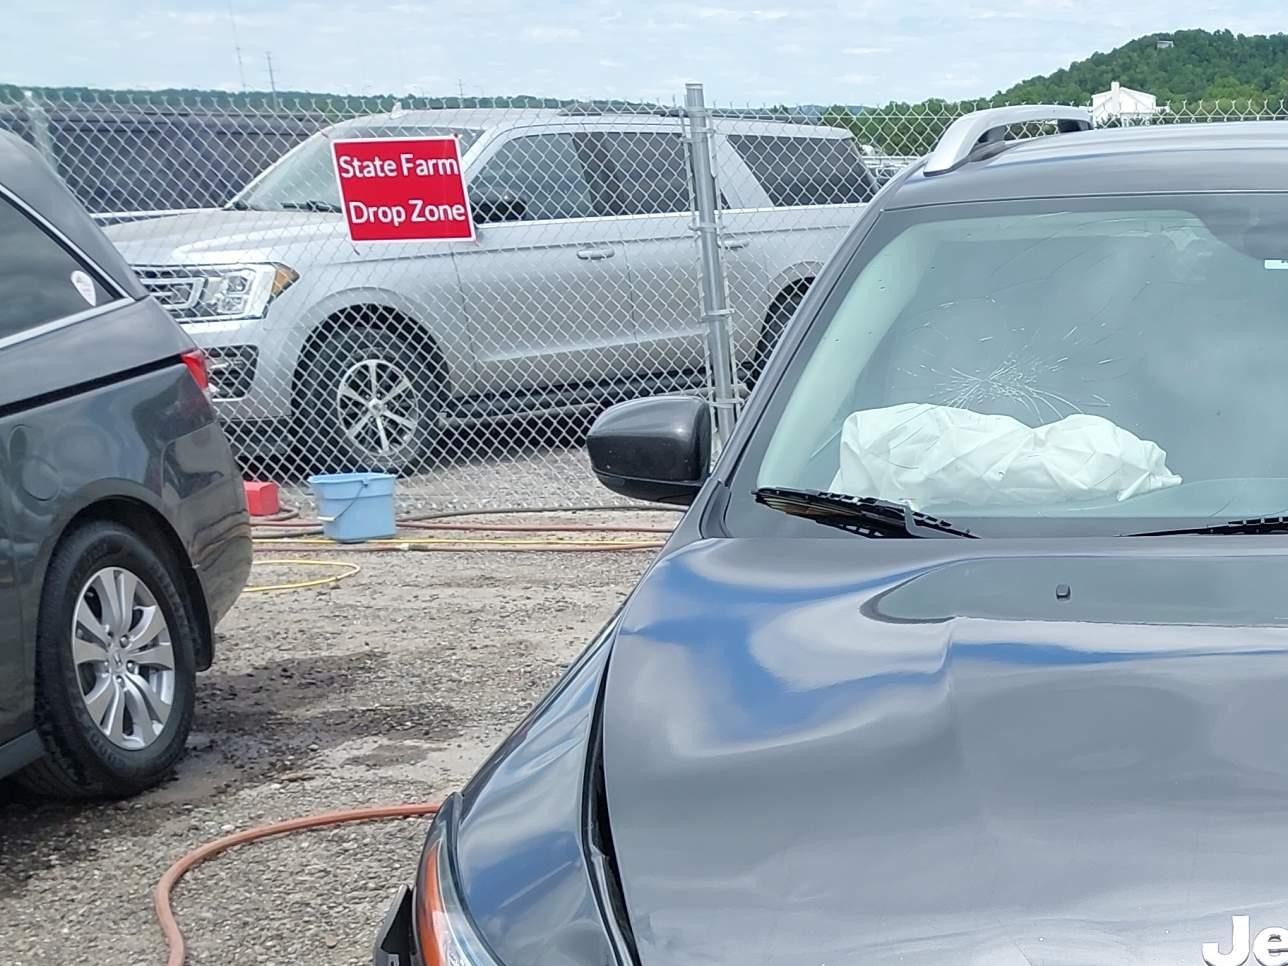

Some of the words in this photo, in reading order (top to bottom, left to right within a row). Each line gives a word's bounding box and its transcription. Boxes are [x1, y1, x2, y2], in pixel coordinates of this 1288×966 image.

[339, 155, 398, 178] State
[401, 153, 459, 176] Farm
[349, 201, 406, 227] Drop
[408, 199, 466, 222] Zone
